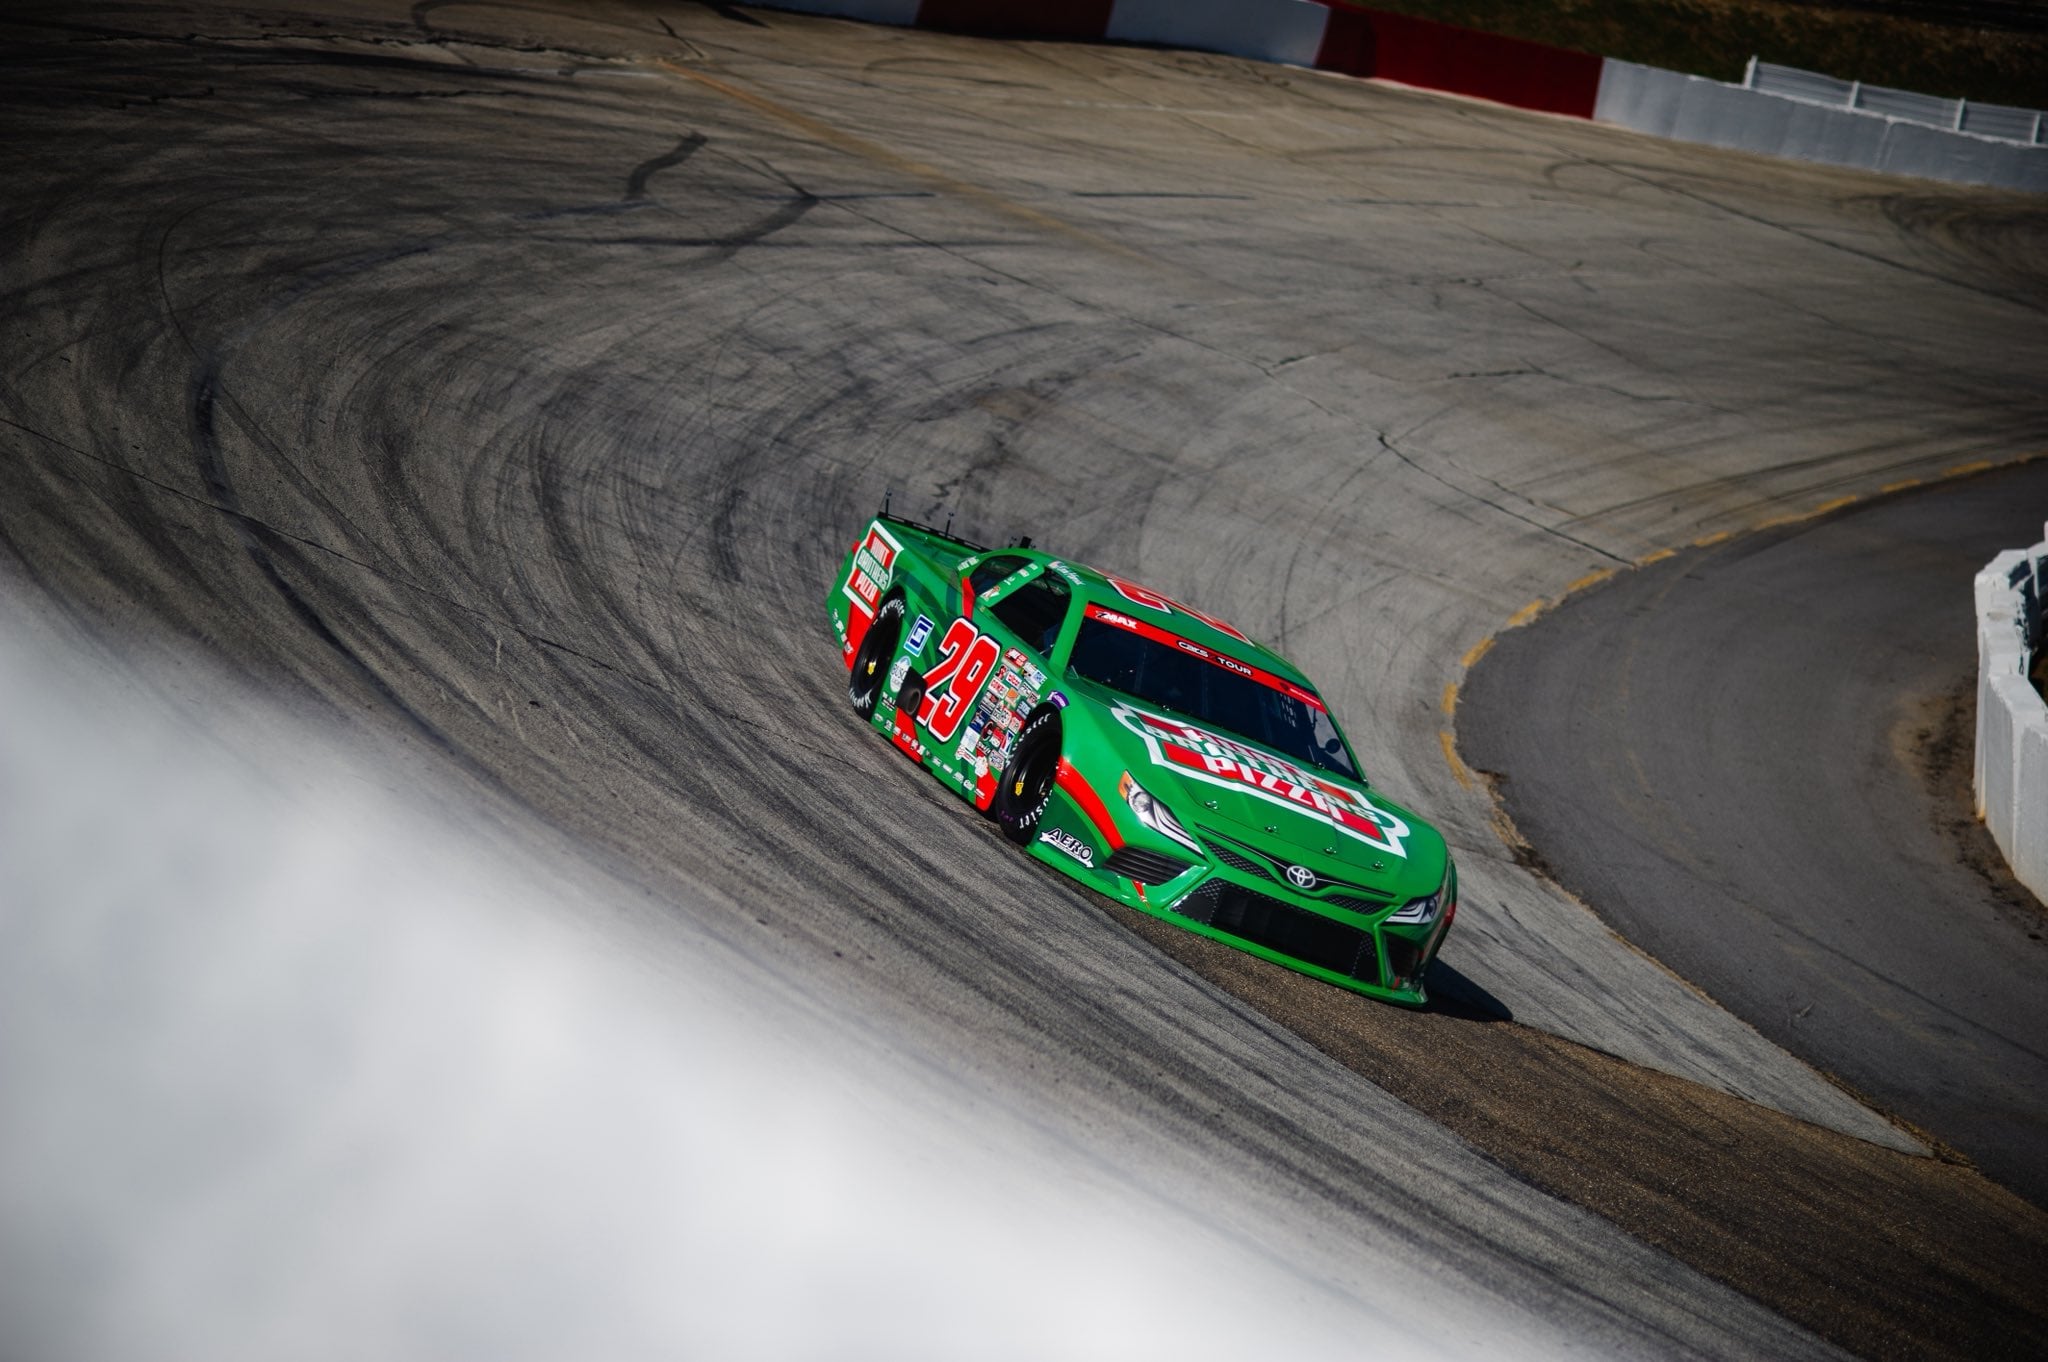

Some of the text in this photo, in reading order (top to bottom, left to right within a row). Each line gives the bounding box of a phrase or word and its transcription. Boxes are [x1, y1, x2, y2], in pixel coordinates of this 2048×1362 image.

[915, 617, 1000, 743] 29
[1217, 656, 1252, 677] TOUR
[1144, 723, 1382, 825] BROTHERS
[1201, 754, 1345, 822] PIZZA
[1047, 828, 1094, 861] AERO
